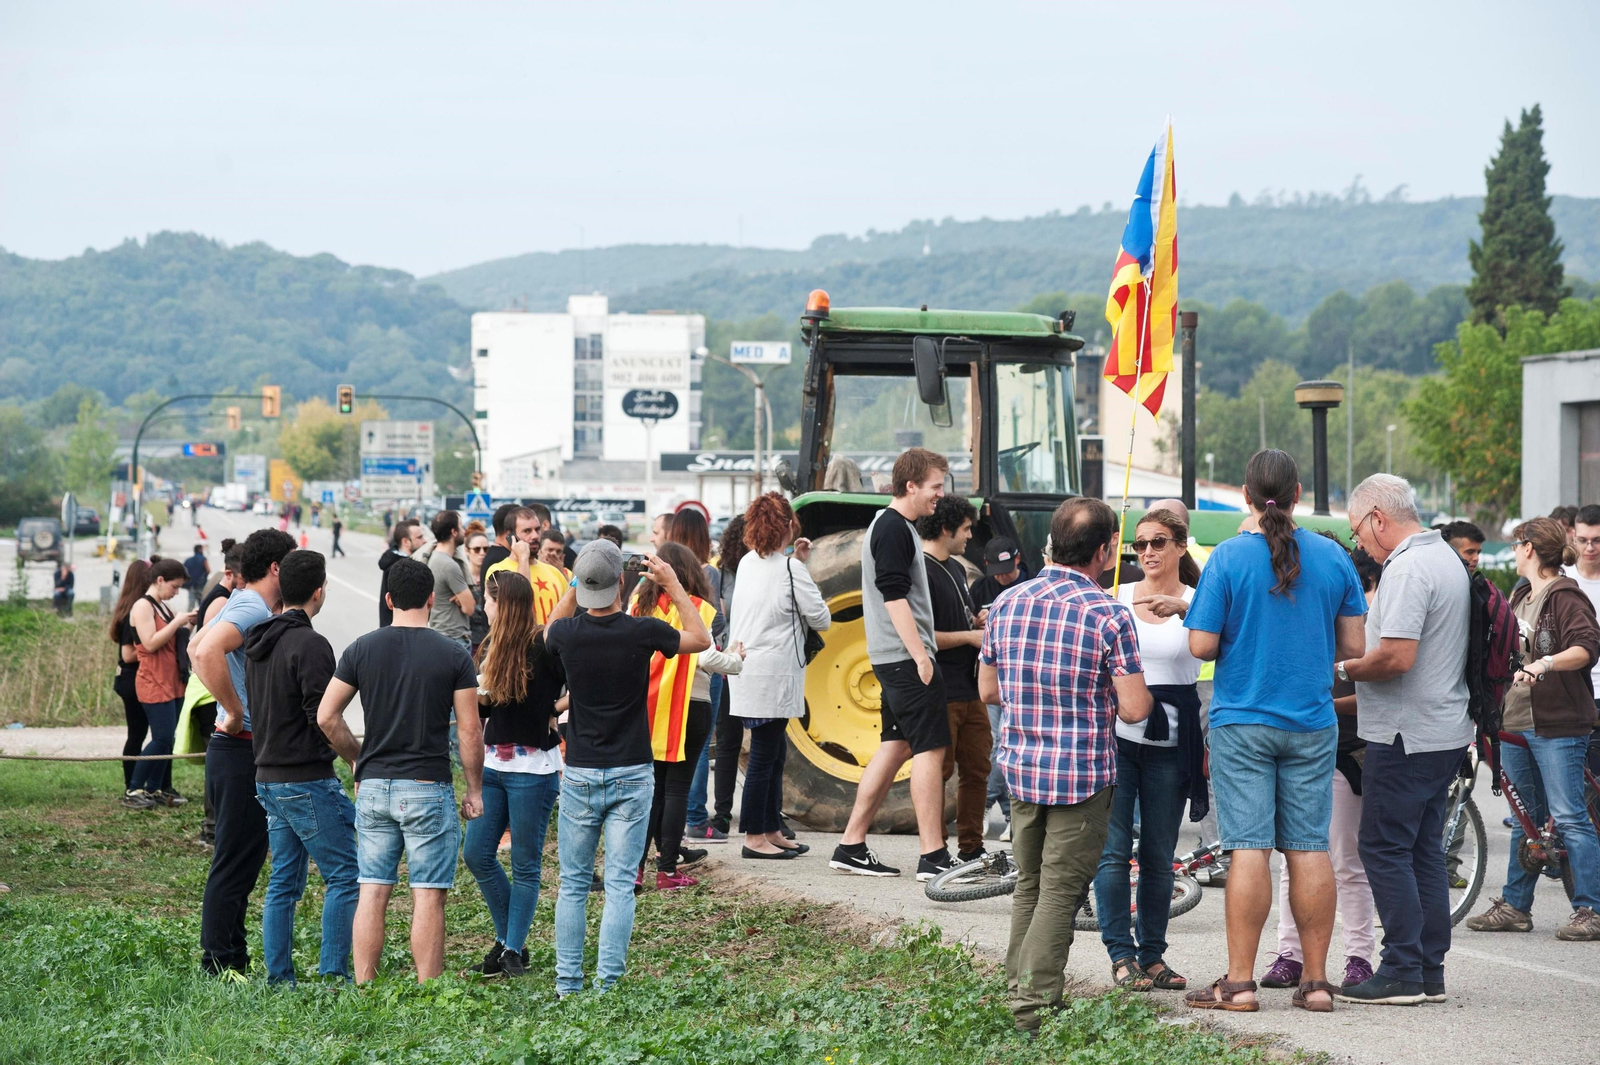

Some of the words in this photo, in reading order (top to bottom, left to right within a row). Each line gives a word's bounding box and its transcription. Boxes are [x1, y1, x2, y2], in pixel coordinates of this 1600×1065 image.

[733, 346, 764, 358] MED
[778, 346, 789, 358] A
[686, 453, 784, 473] Snak
